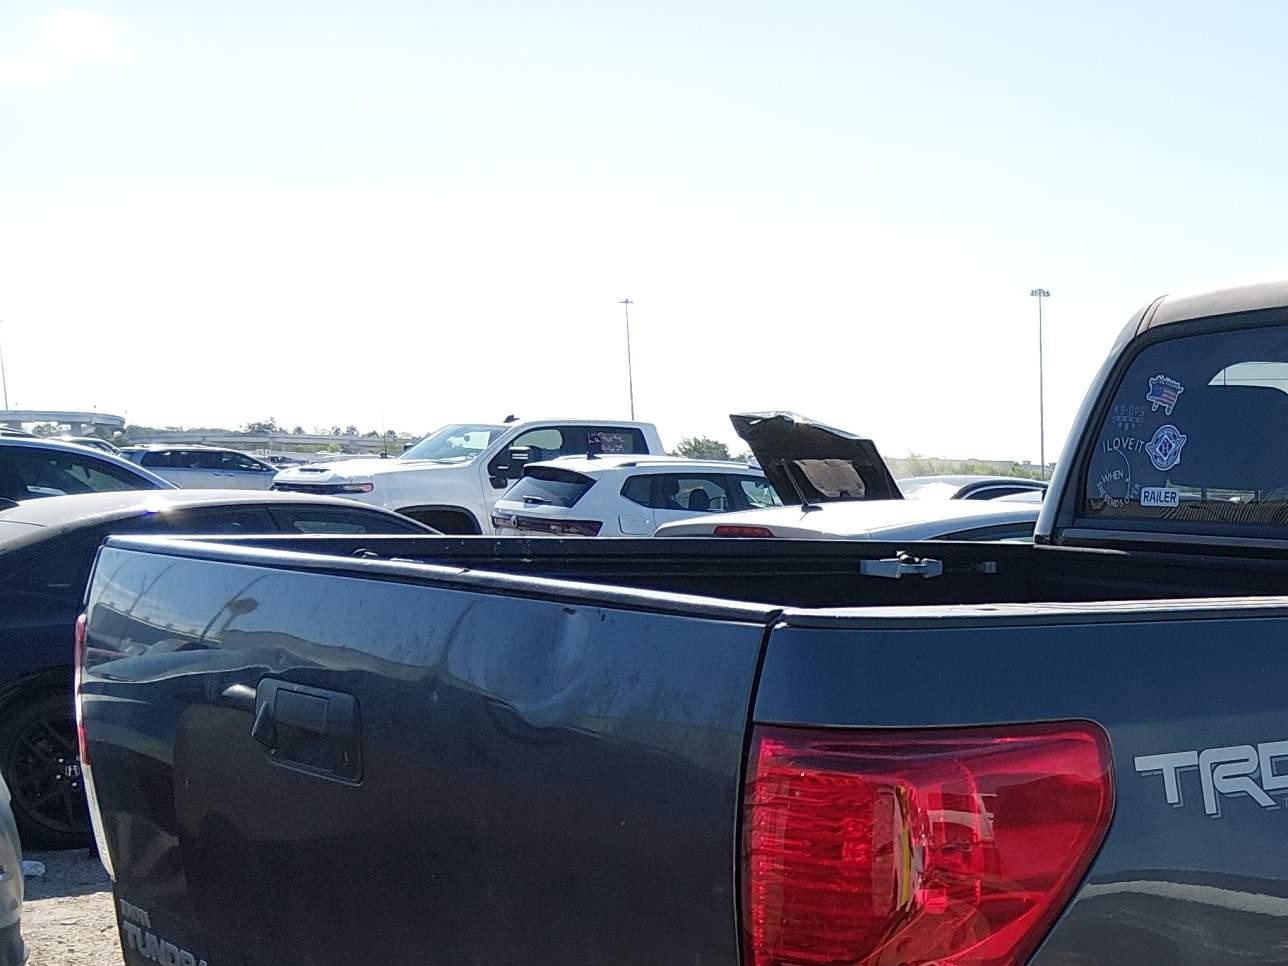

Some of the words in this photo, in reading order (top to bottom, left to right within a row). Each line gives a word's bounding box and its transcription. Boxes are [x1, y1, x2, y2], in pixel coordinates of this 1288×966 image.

[1107, 436, 1135, 451] LOVE
[1135, 440, 1146, 453] IT
[1101, 469, 1124, 483] WHEN
[1143, 490, 1177, 503] RAILER
